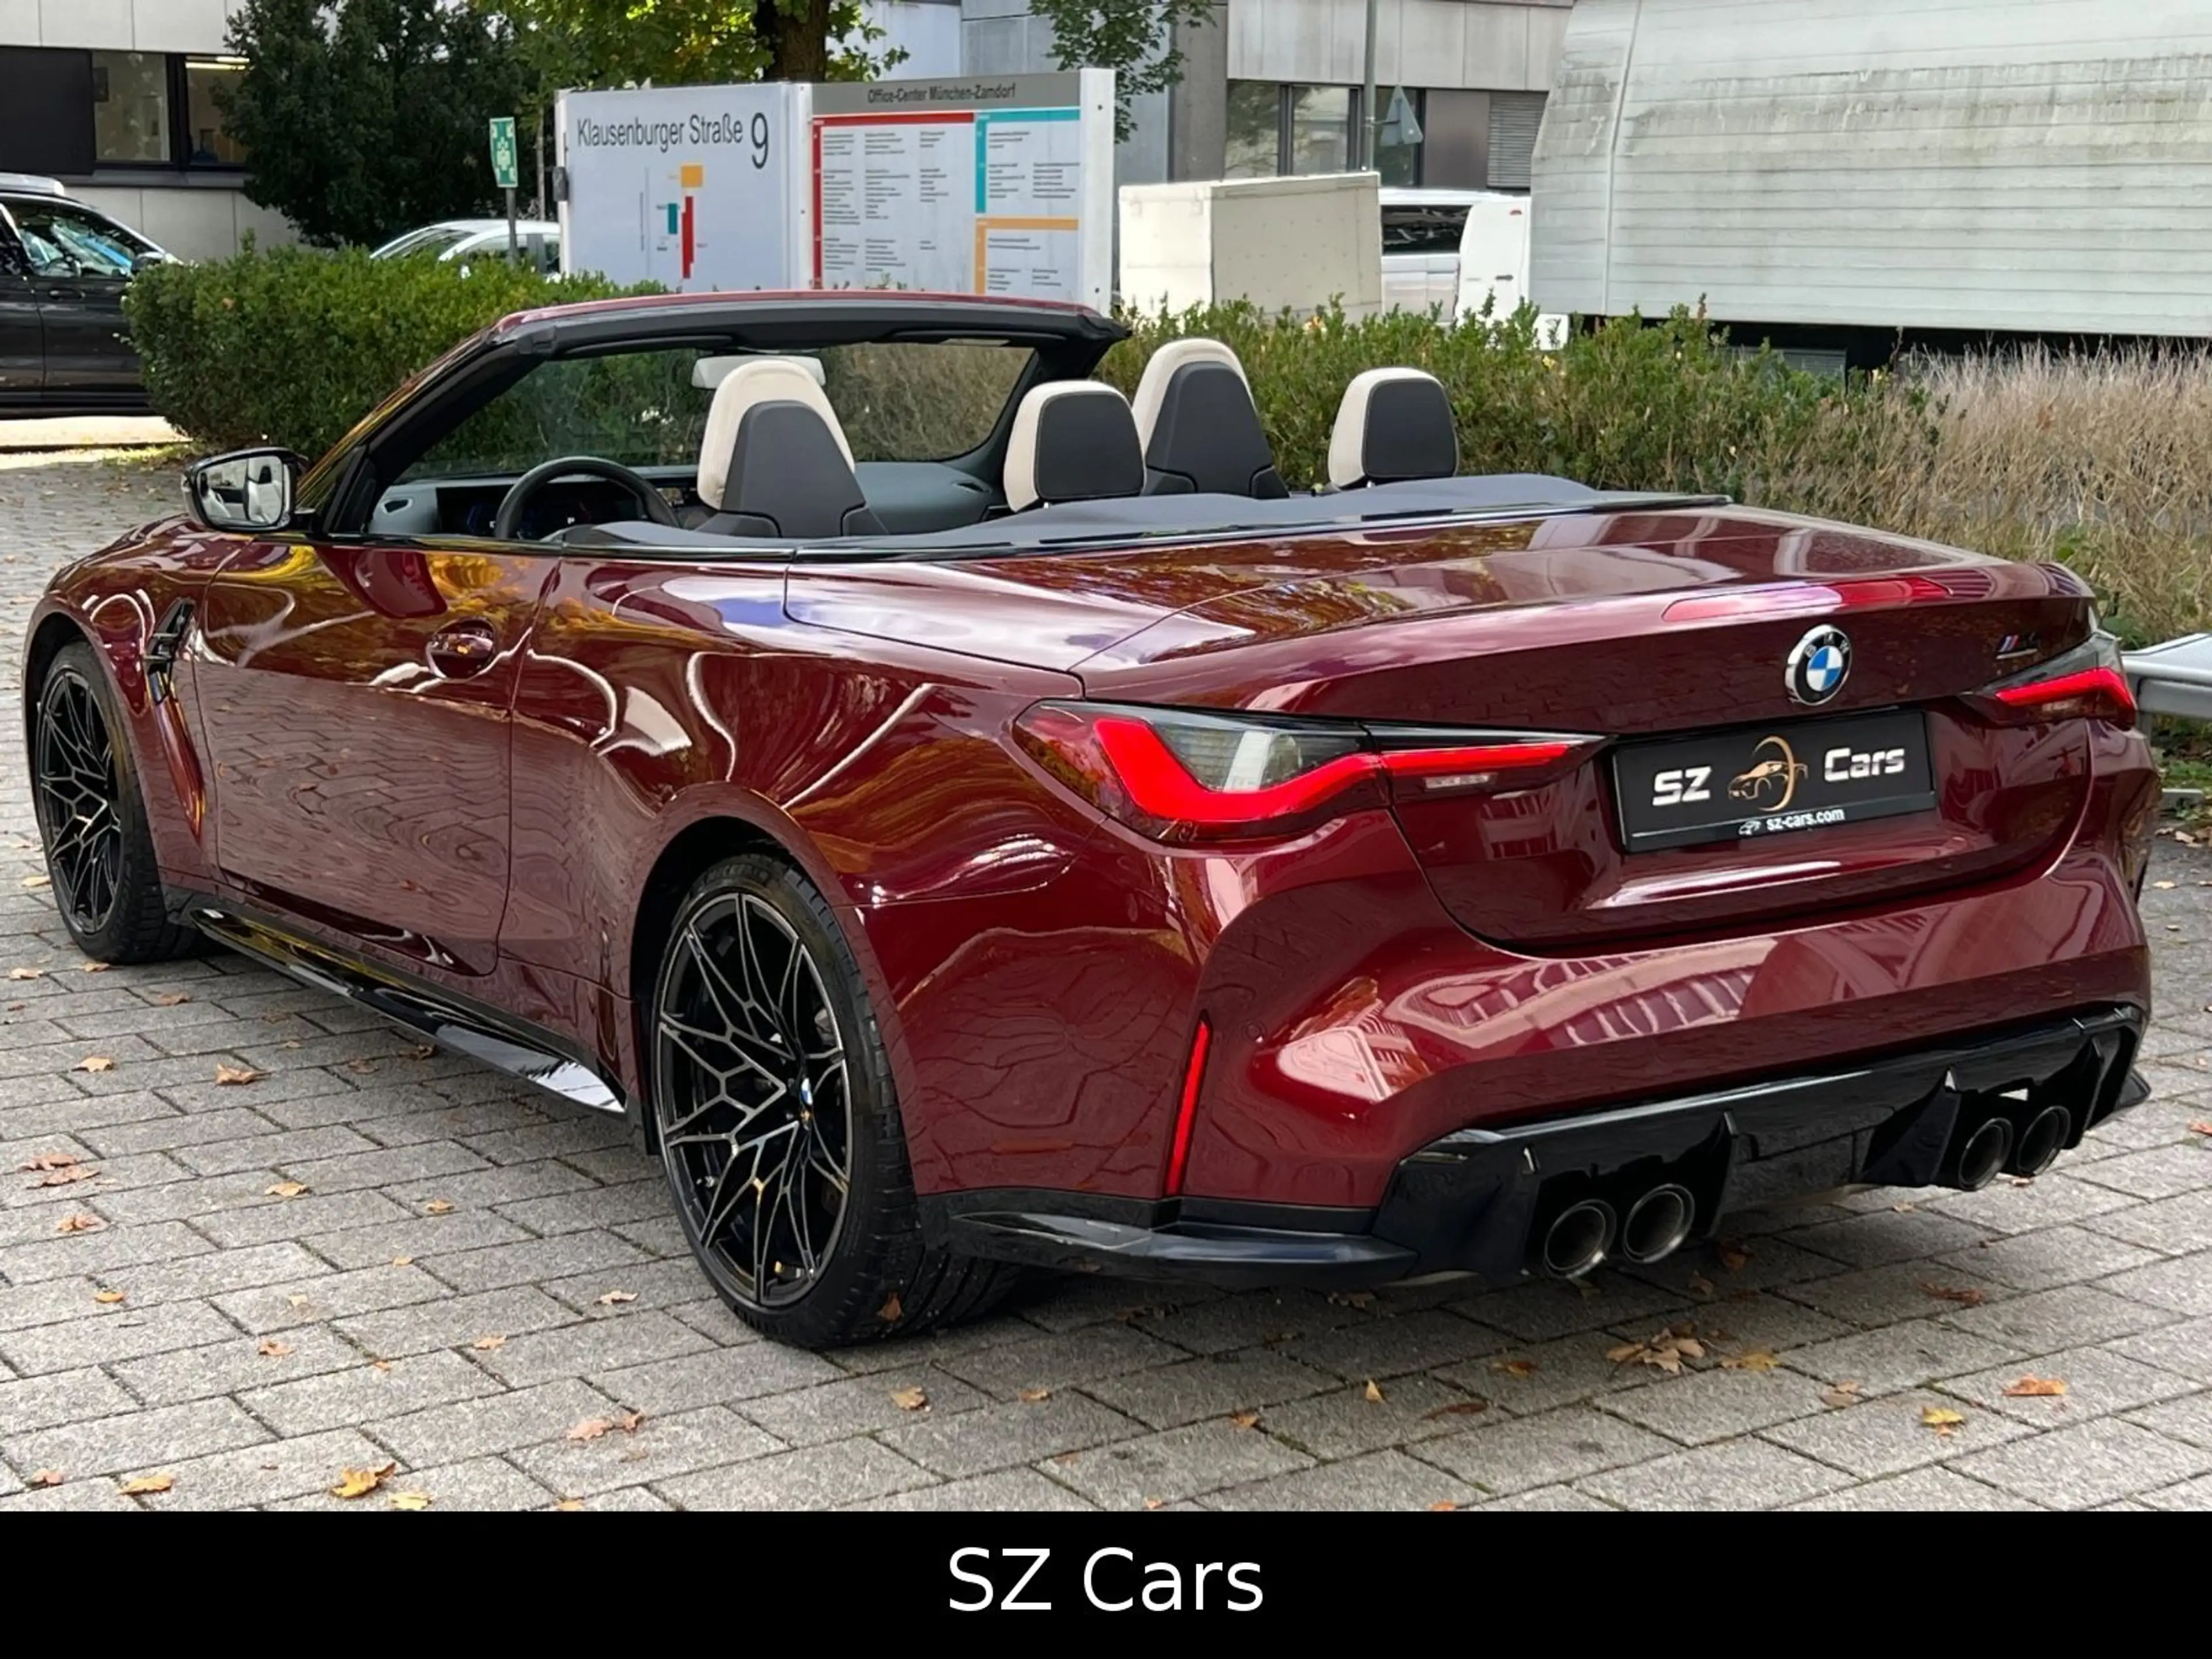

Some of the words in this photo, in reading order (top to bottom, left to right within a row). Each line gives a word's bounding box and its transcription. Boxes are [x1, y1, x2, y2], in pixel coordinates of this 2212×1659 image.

[868, 88, 927, 103] Office-Center
[929, 84, 1016, 100] München-Zamdorf
[578, 118, 684, 153] Klausenburger
[690, 113, 743, 145] Straße
[751, 112, 768, 169] 9
[1652, 766, 1711, 806] SZ
[1824, 748, 1904, 782] Cars
[1766, 808, 1846, 831] sz-cars.com
